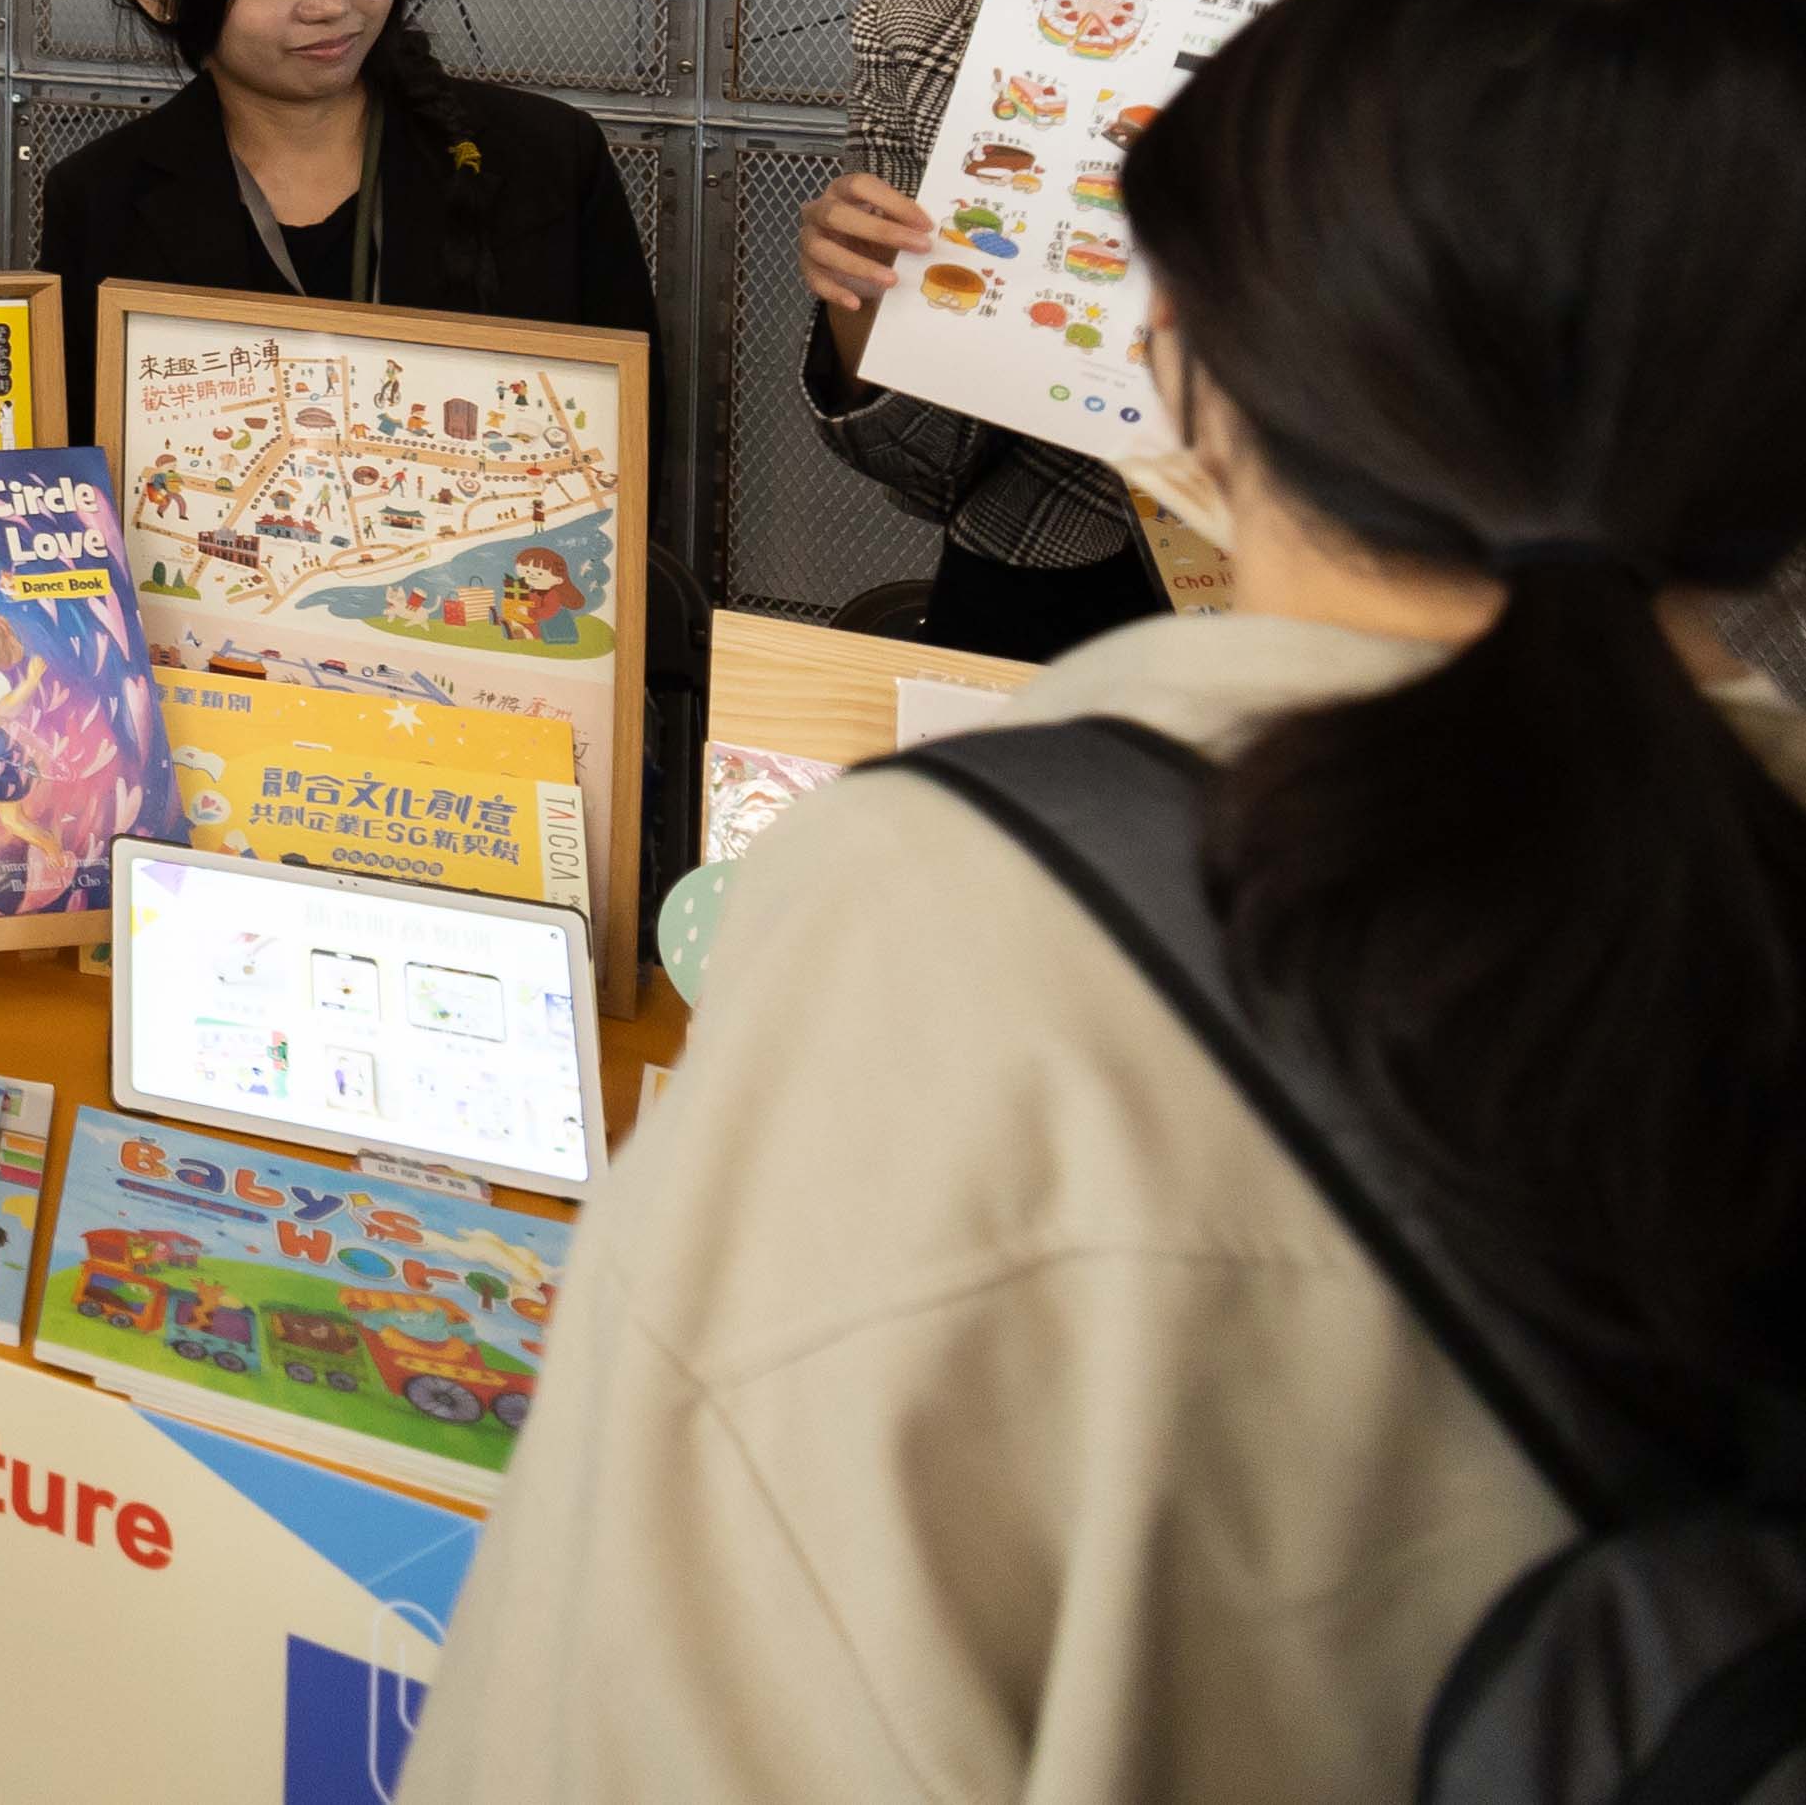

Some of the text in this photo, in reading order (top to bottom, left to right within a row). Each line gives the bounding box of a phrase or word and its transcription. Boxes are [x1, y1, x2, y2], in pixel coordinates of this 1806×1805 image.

[6, 527, 109, 563] Love
[22, 577, 105, 594] Dance Book
[262, 766, 517, 837] 融合文化創意
[250, 803, 521, 867] 共創企業ESG新契機
